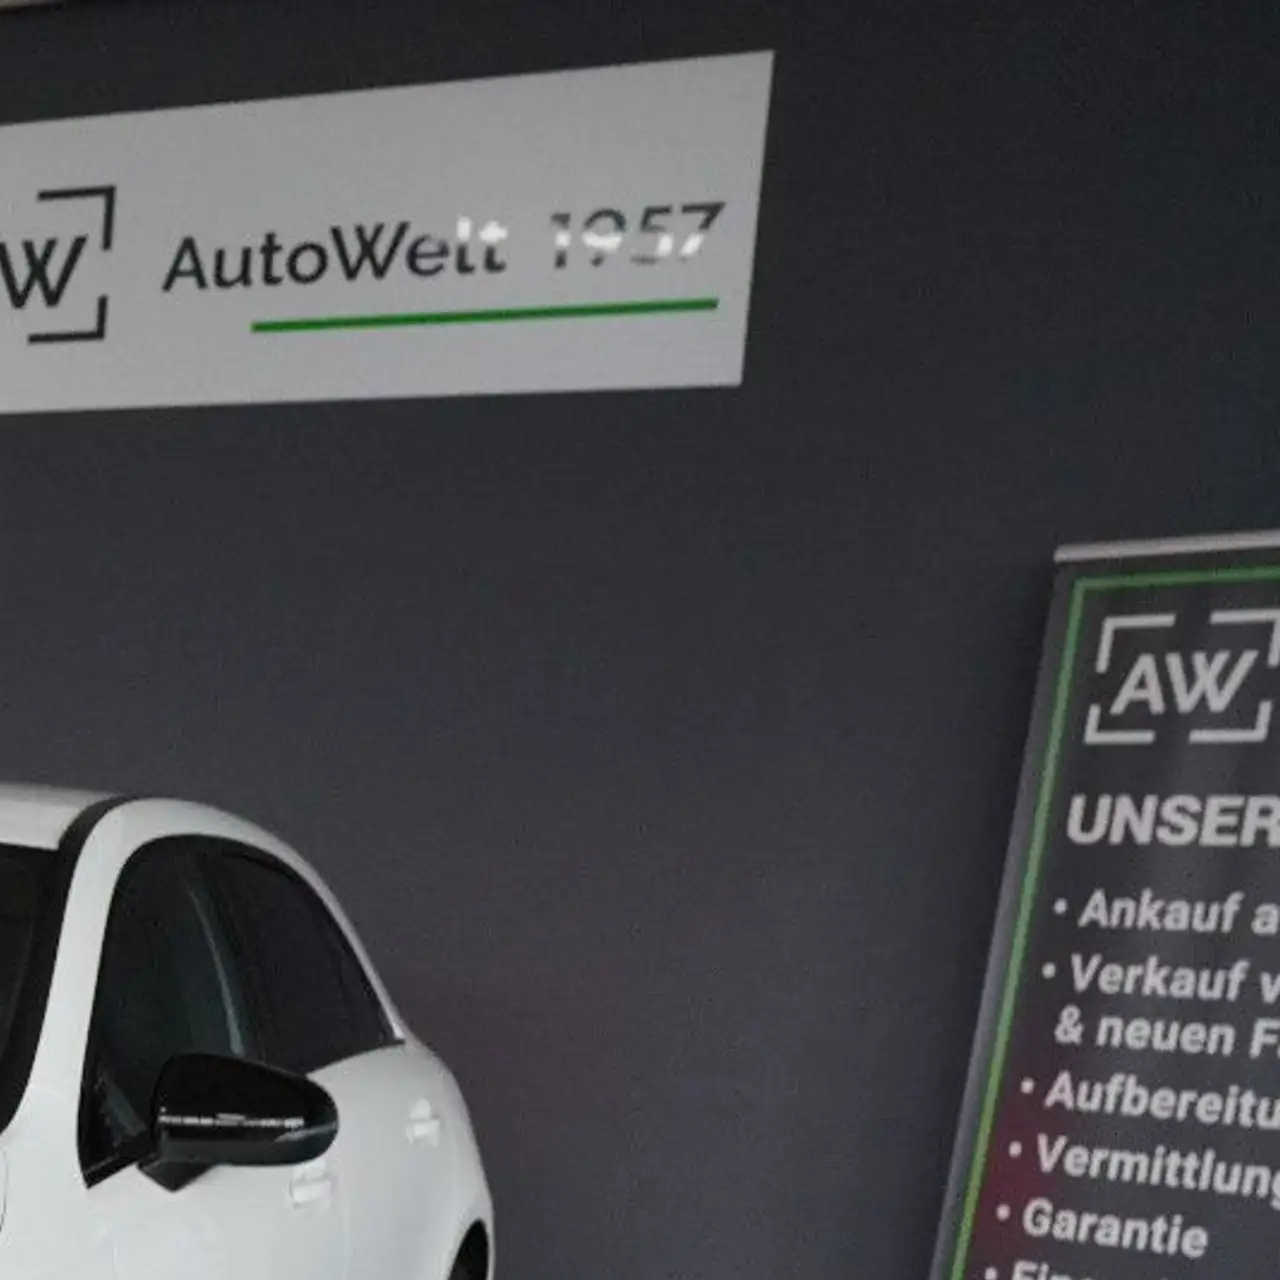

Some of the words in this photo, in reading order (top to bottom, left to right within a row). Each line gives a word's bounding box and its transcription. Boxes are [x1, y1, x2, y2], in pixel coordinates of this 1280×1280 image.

[162, 219, 507, 292] AutoWelt
[551, 202, 726, 269] 1957
[1109, 649, 1259, 716] AW
[1078, 889, 1245, 934] Ankauf
[1070, 955, 1250, 1002] Verkauf
[1055, 1007, 1083, 1043] &
[1096, 1015, 1235, 1057] neuen
[1249, 1018, 1280, 1060] F
[1023, 1200, 1209, 1259] Garantie
